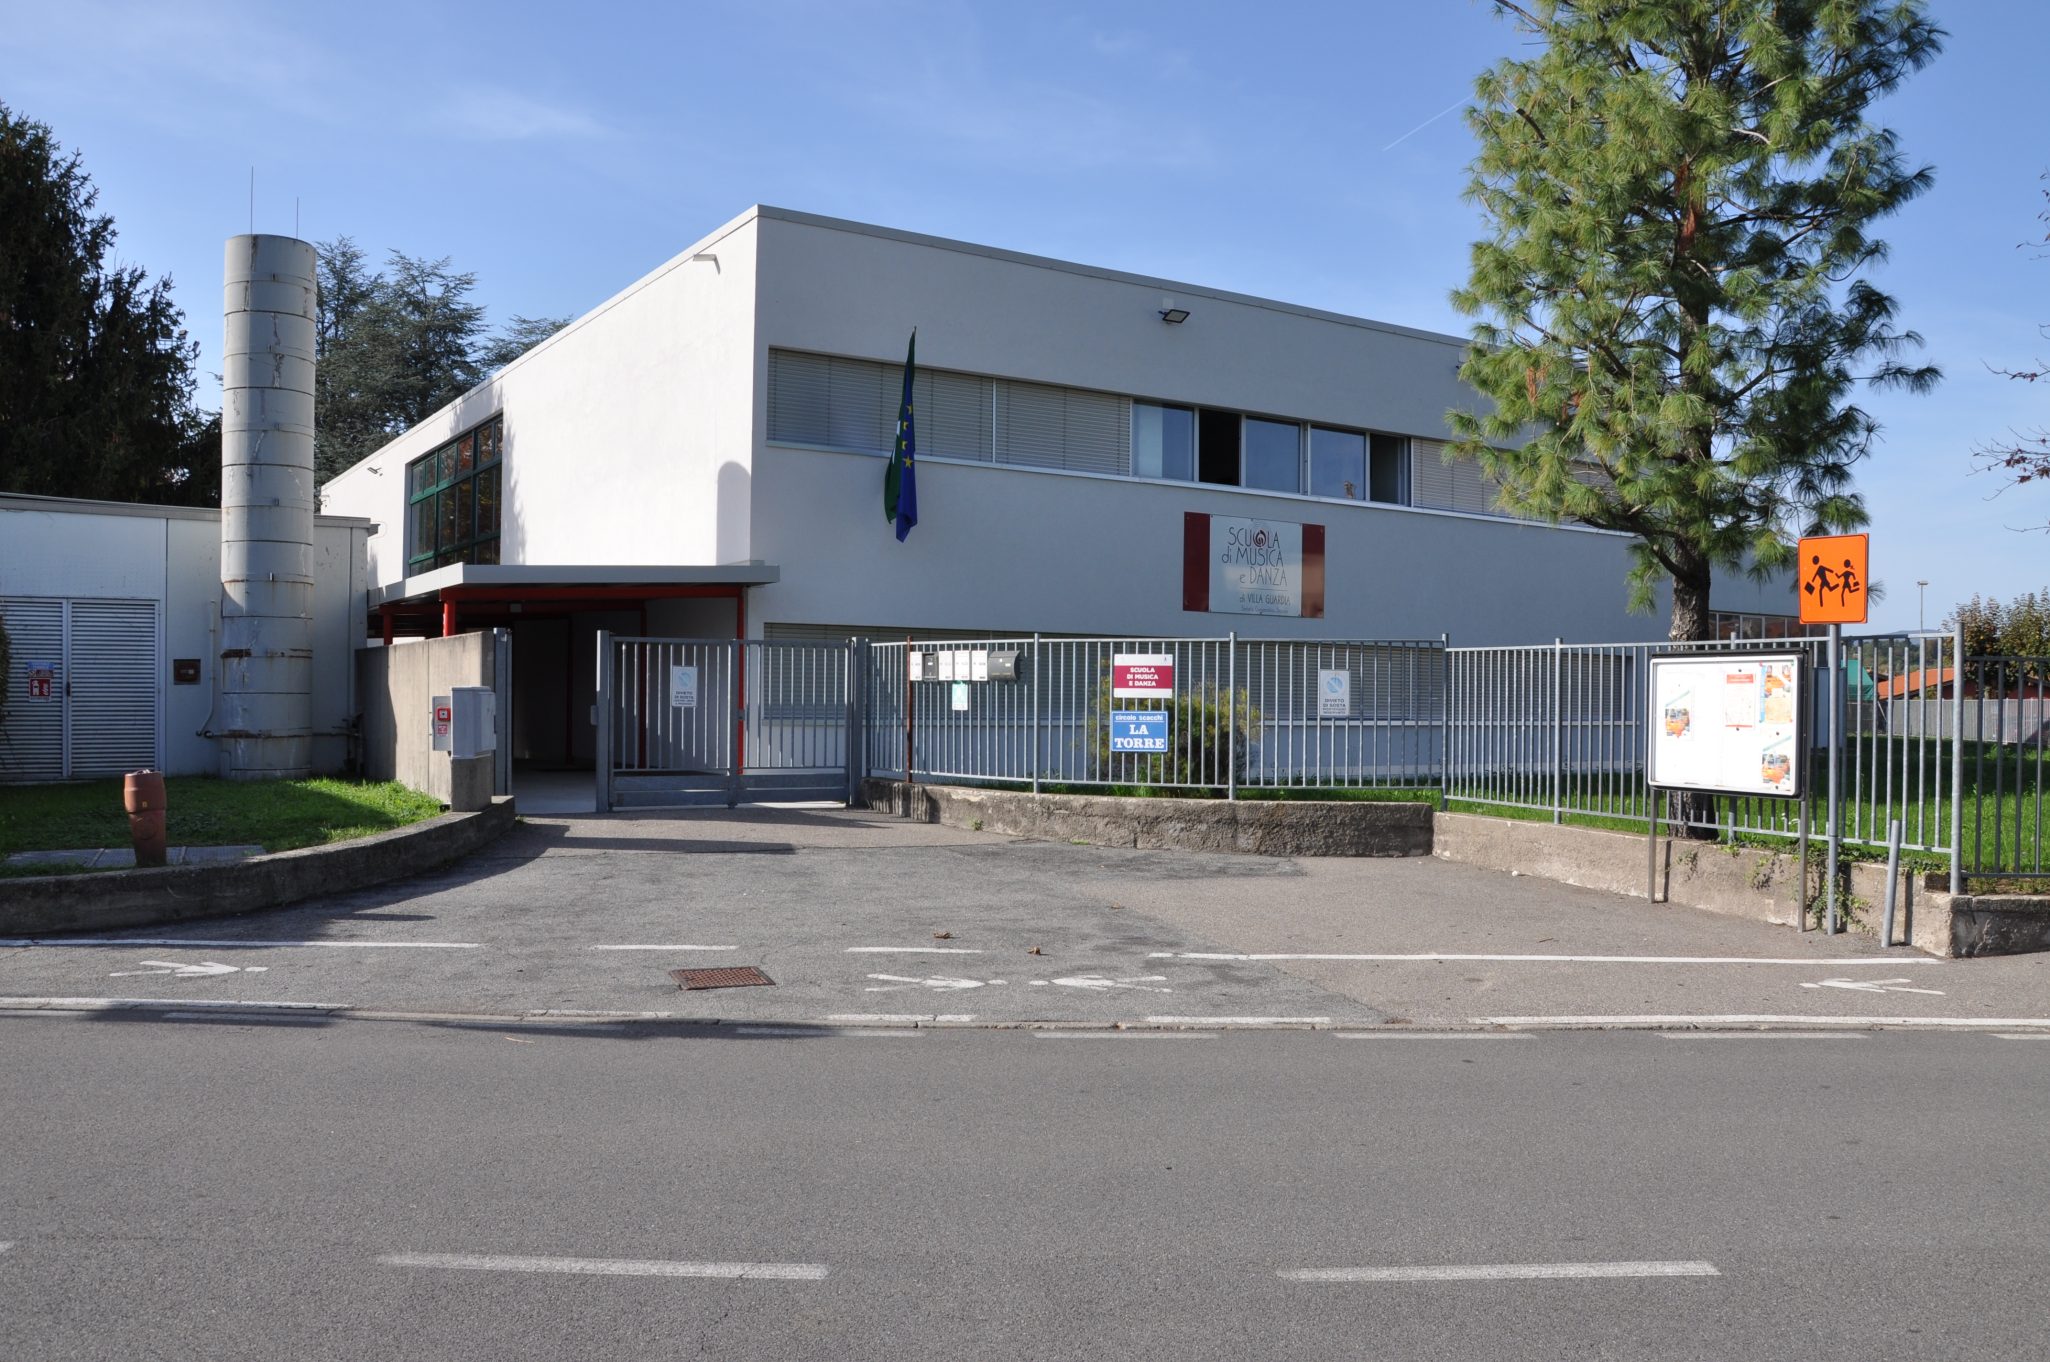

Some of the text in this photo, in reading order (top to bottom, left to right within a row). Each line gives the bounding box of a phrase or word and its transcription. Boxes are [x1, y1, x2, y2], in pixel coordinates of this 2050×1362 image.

[1228, 527, 1280, 549] SCUOLA
[1222, 546, 1284, 567] di MUSICA
[1239, 566, 1287, 586] e DANZA
[1129, 724, 1149, 735] LA
[1114, 738, 1164, 749] TORRE
